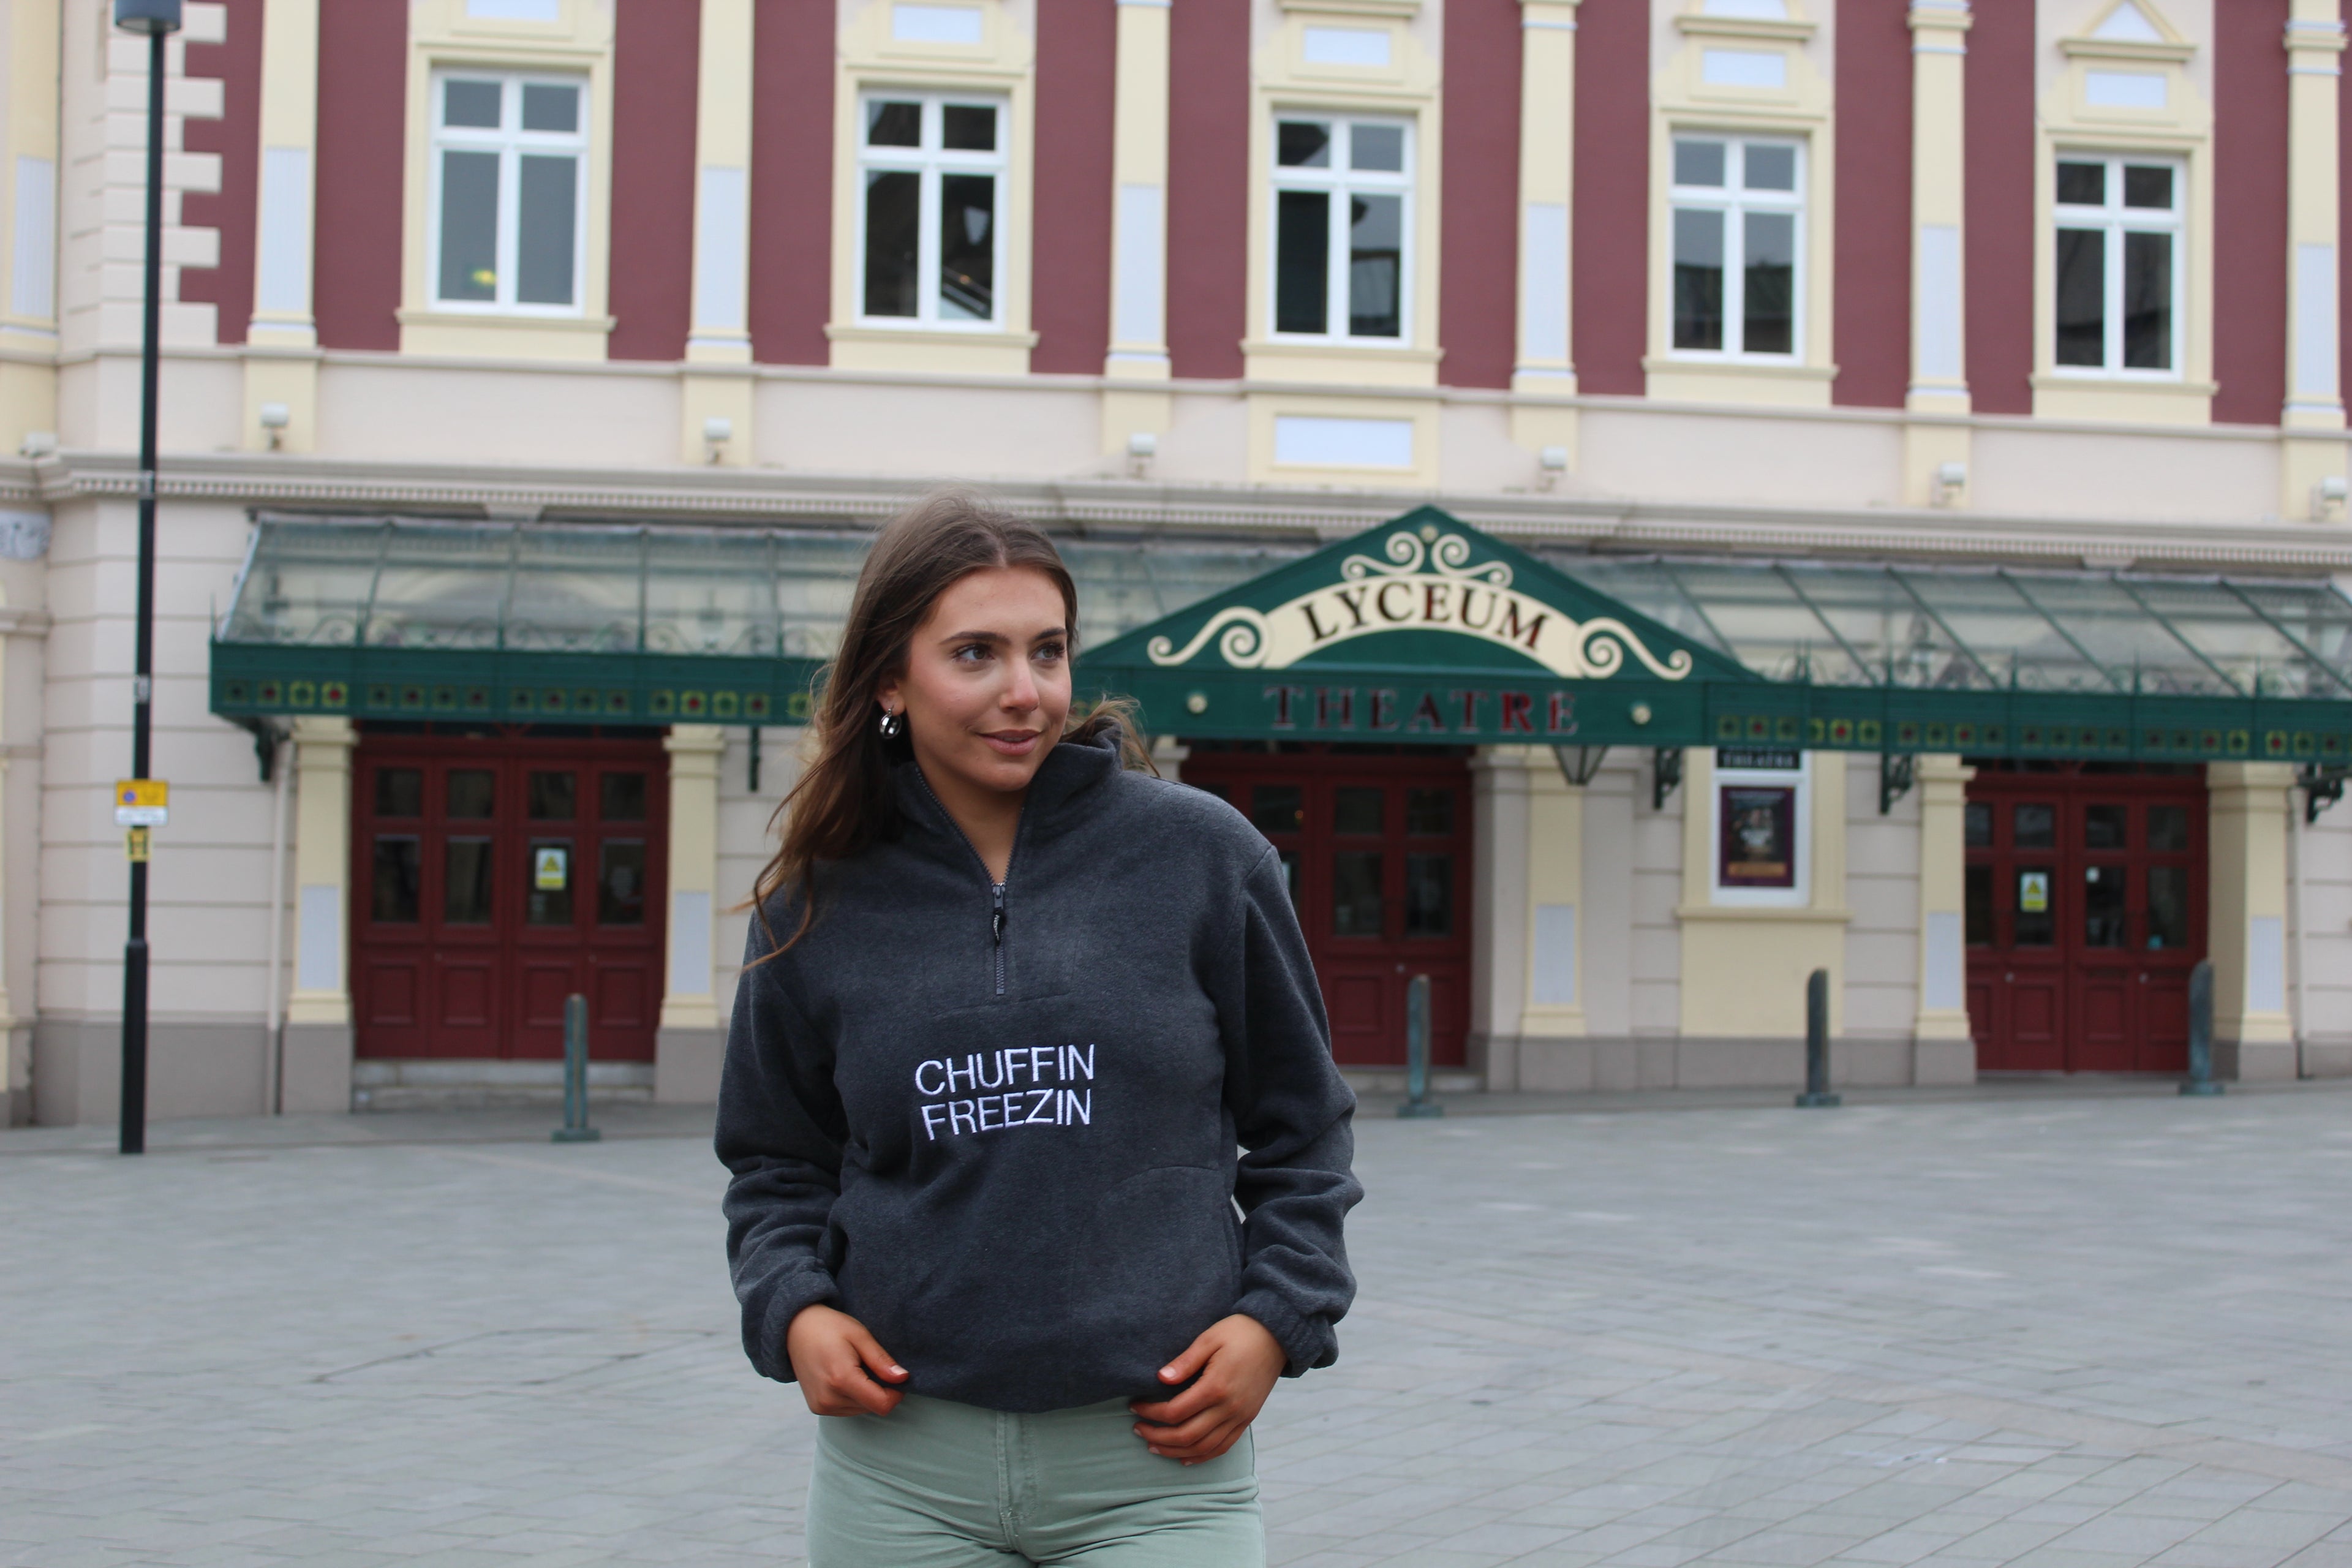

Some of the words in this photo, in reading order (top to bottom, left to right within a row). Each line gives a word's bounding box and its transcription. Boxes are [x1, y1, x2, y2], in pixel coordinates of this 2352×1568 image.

[1299, 580, 1548, 650] LYCEUM
[1262, 685, 1579, 734] THEATRE
[915, 1044, 1095, 1096] CHUFFIN
[921, 1088, 1091, 1140] FREEZIN
